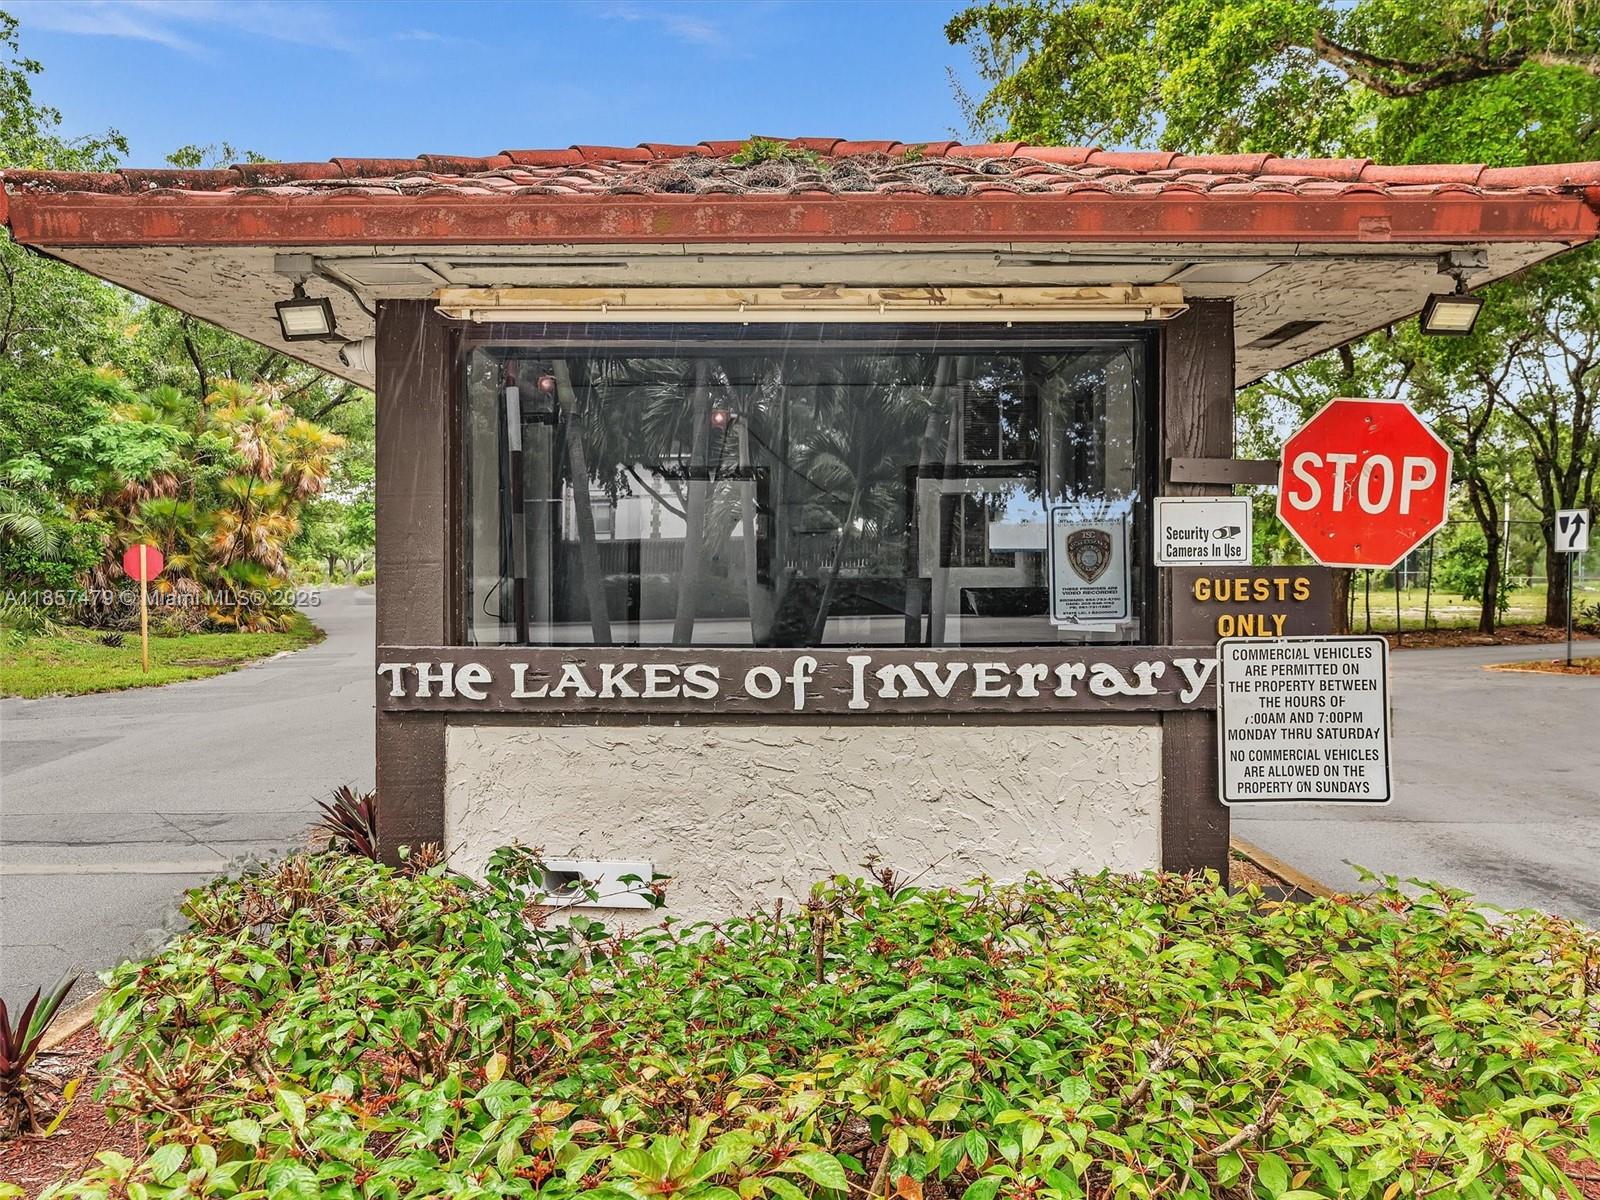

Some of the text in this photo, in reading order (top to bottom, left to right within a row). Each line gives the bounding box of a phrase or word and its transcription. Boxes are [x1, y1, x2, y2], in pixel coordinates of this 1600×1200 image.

[1288, 452, 1437, 515] STOP
[1166, 526, 1209, 542] Security
[1166, 543, 1242, 558] Cameras In Use
[1194, 577, 1311, 602] GUESTS
[1218, 614, 1287, 637] ONLY
[1232, 646, 1372, 661] COMMERCIAL VEHICLES
[1245, 663, 1359, 676] ARE PERMITTED ON
[510, 662, 720, 699] LAKES
[1229, 679, 1377, 693] THE PROPERTY BETWEEN
[1259, 695, 1346, 708] THE HOURS OF
[1289, 712, 1314, 724] AND
[1318, 711, 1363, 724] 7:00PM
[1228, 727, 1381, 741] MONDAY THRU SATURDAY
[1230, 748, 1379, 762] NO COMMERCIAL VEHICLES
[1244, 764, 1365, 778] ARE ALLOWED ON THE
[1237, 780, 1370, 794] PROPERTY ON SUNDAYS
